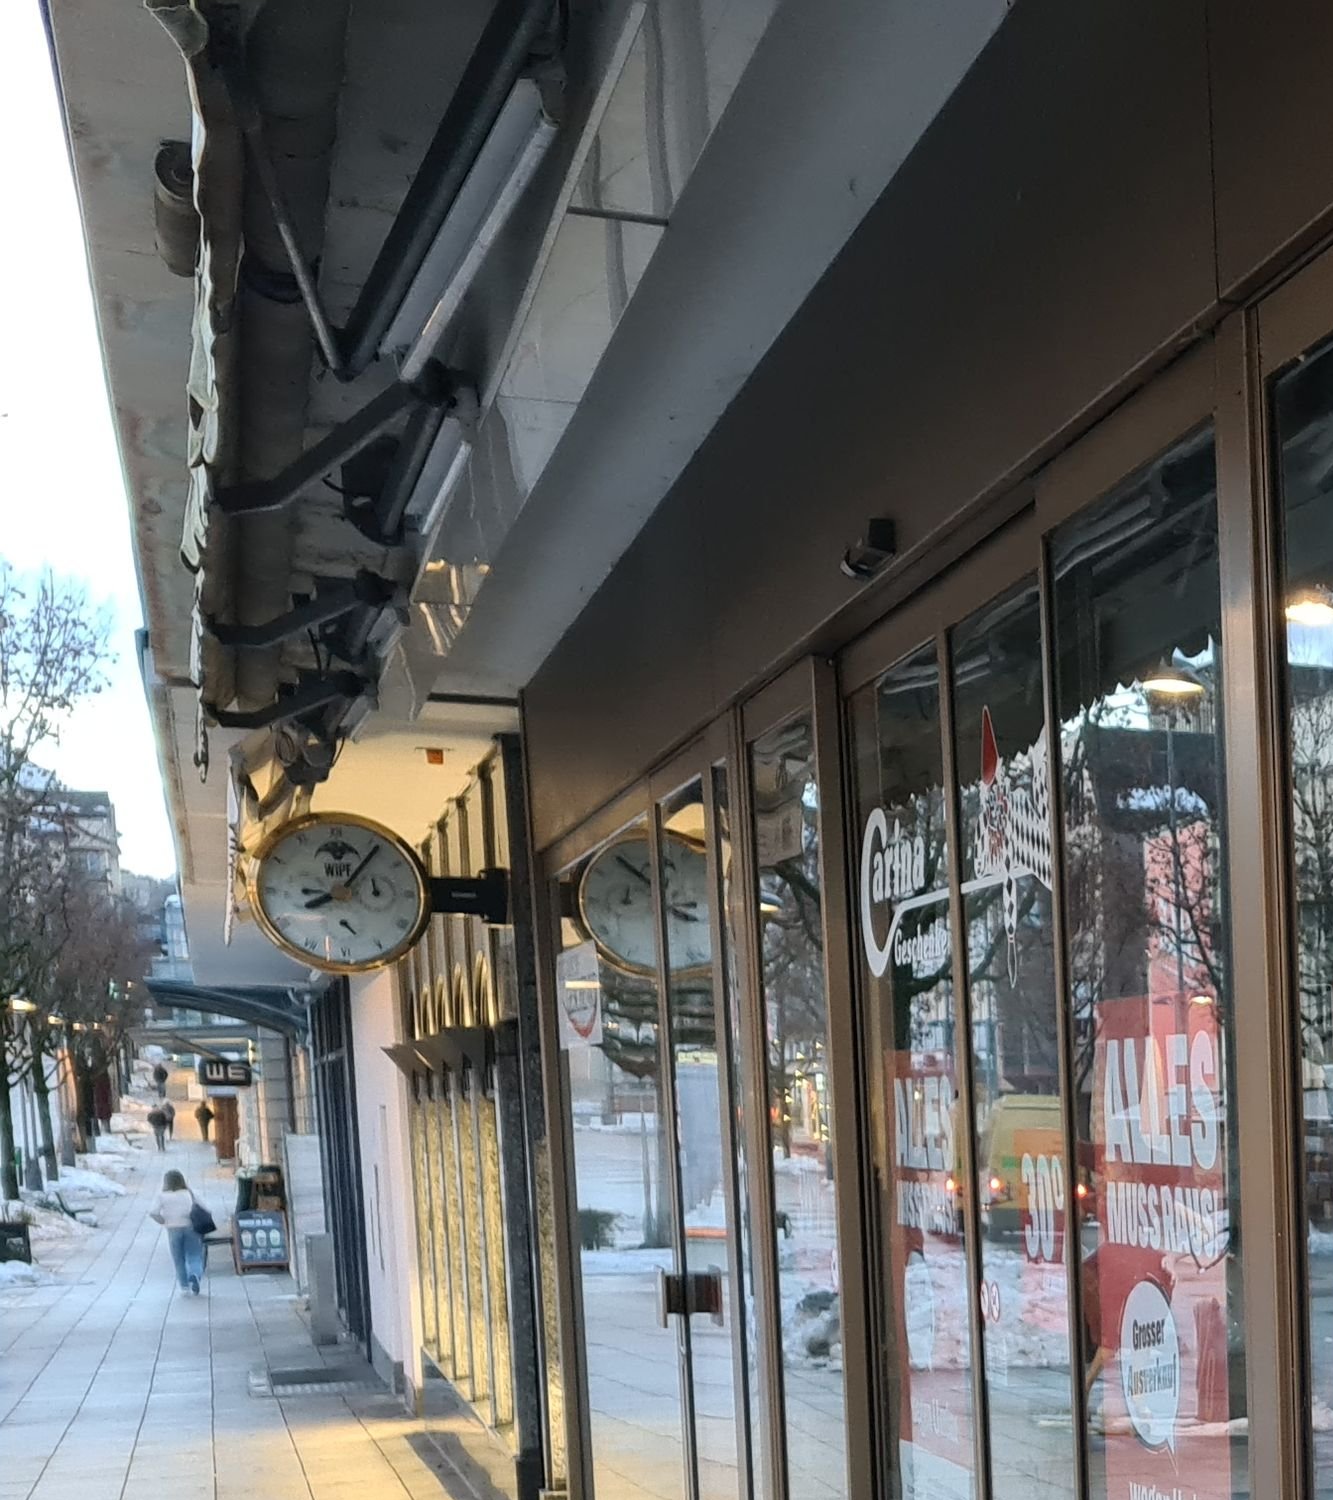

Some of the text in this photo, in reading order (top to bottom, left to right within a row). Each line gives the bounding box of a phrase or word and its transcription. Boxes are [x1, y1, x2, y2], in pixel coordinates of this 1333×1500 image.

[861, 807, 925, 978] Carina
[894, 919, 948, 967] Geschenke
[894, 1074, 954, 1171] ALLES
[1105, 1031, 1219, 1169] ALLES
[1107, 1181, 1161, 1248] MUSS
[1132, 1317, 1165, 1349] Grosser
